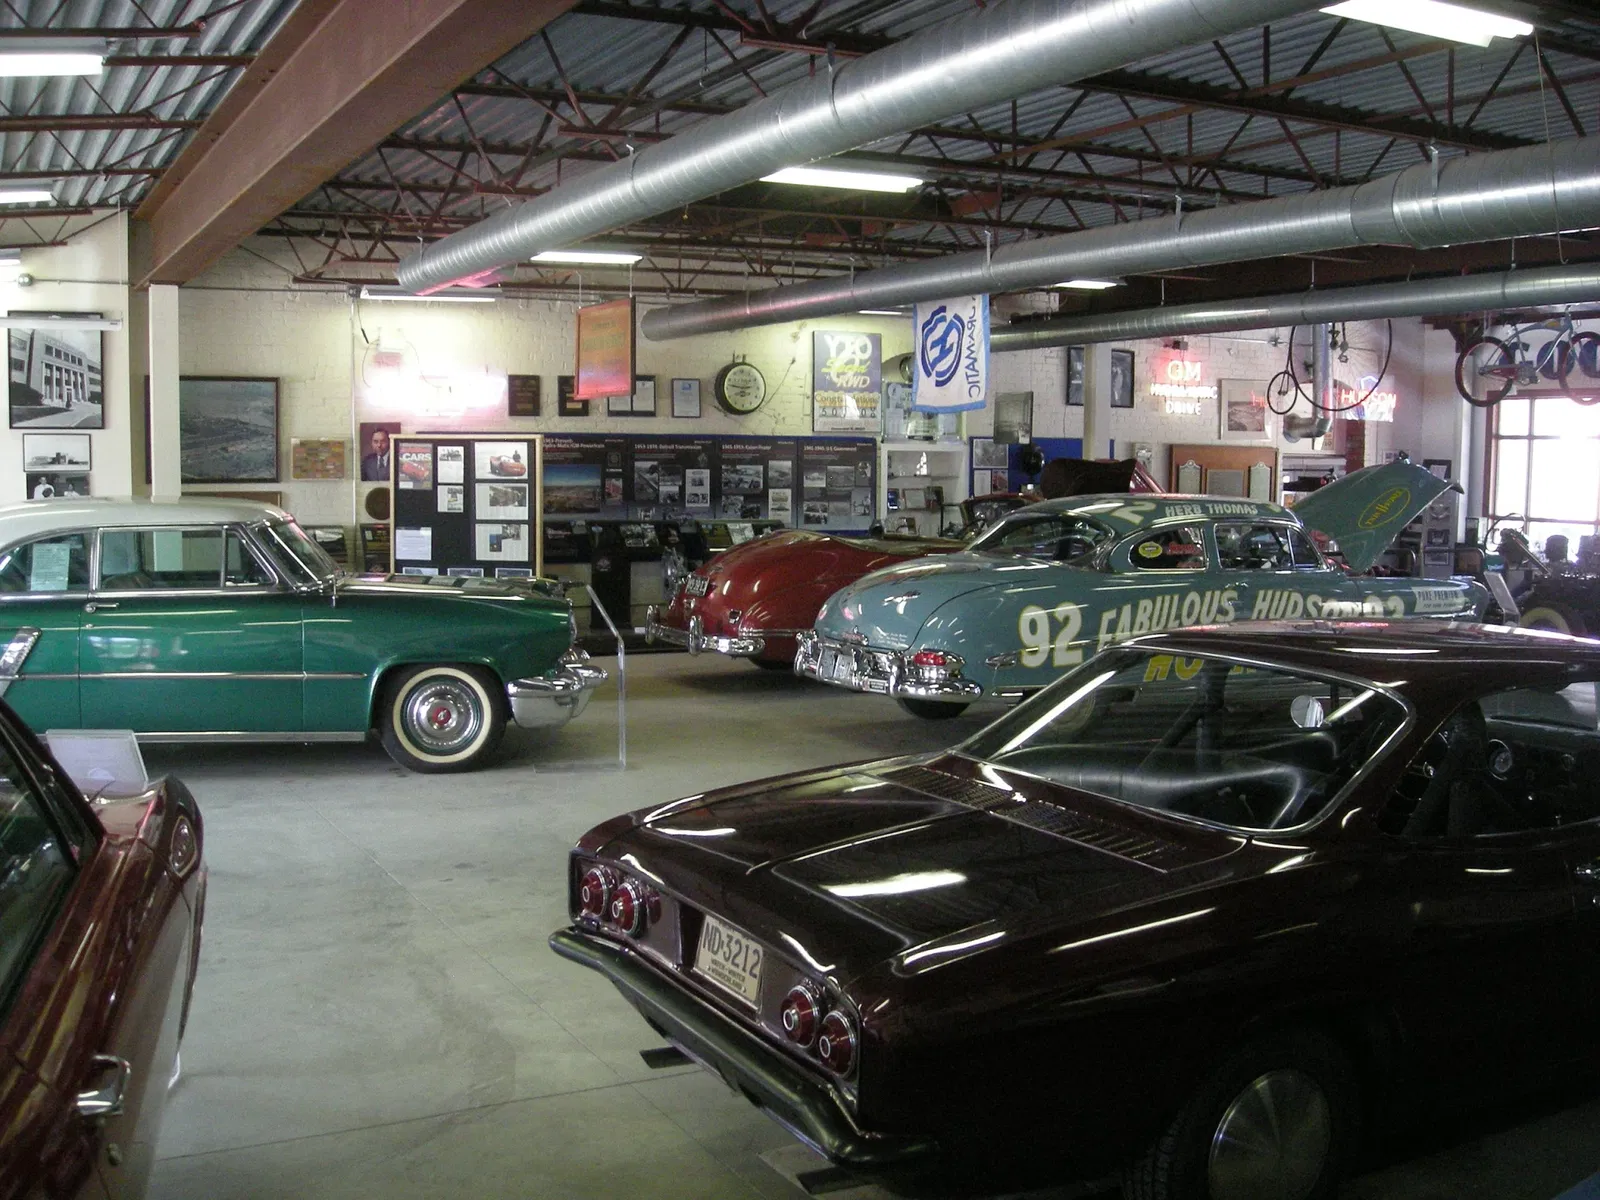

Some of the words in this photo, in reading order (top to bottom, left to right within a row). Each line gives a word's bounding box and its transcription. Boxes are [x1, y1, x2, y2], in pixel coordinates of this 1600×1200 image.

[402, 452, 432, 461] CARS
[1165, 504, 1204, 517] HERB
[1206, 503, 1259, 515] THOMAS
[1018, 601, 1084, 669] 92
[1096, 589, 1238, 650] FABULOUS
